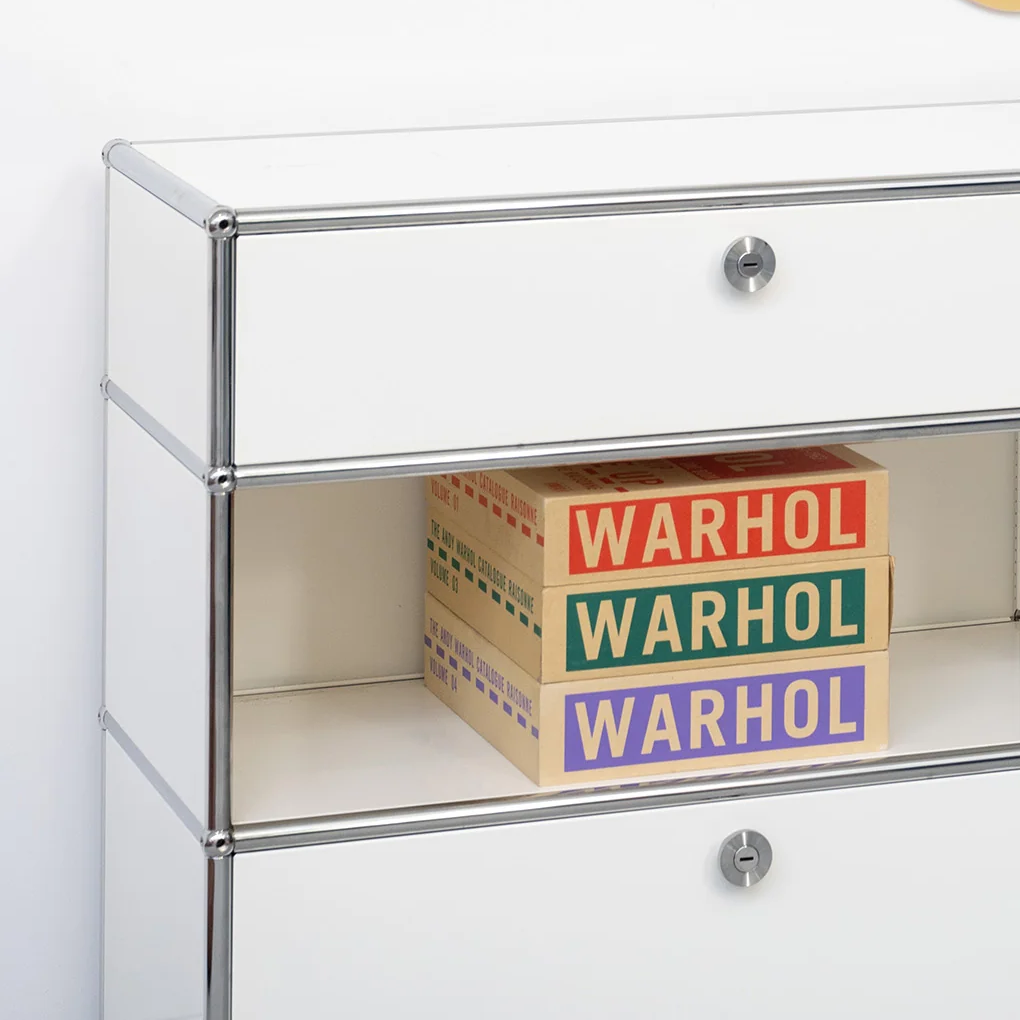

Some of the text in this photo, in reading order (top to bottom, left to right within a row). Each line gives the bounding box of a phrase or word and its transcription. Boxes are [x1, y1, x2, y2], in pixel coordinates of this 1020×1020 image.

[609, 471, 664, 485] UP
[575, 489, 857, 569] WARHOL
[575, 578, 858, 661] WARHOL
[574, 676, 857, 761] WARHOL
